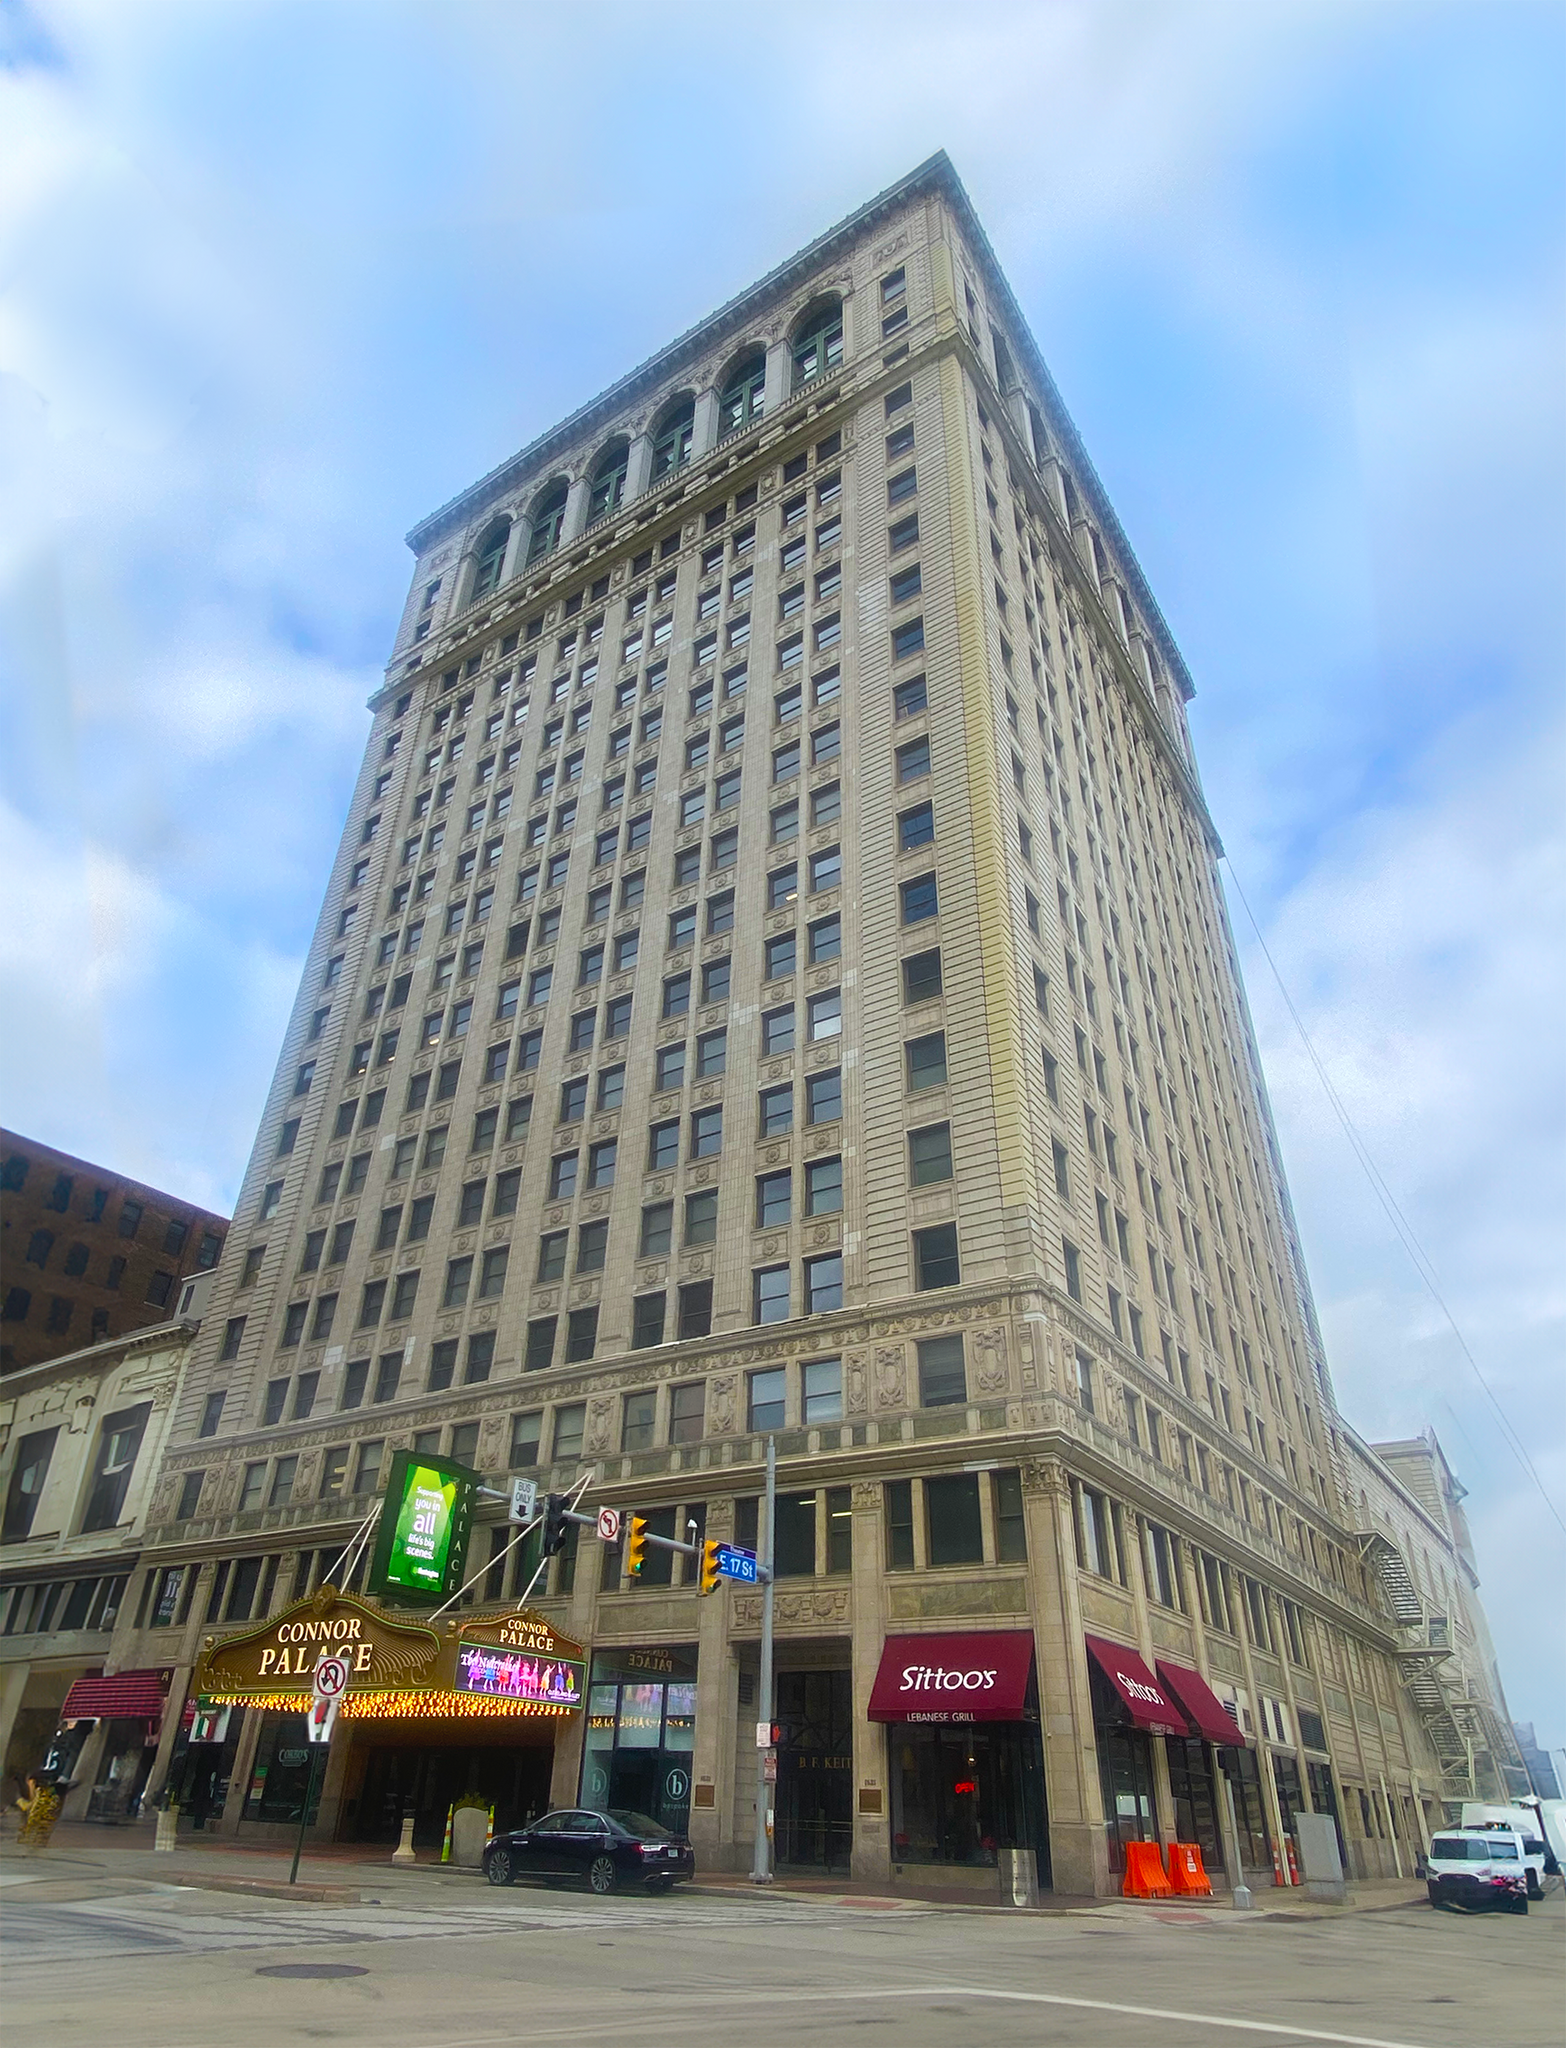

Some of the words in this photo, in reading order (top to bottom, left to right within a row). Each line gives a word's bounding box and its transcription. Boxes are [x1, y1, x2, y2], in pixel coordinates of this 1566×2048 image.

[416, 1485, 444, 1501] Supporting
[518, 1481, 532, 1493] BUS
[415, 1498, 428, 1511] you
[432, 1501, 441, 1512] in
[515, 1492, 532, 1504] ONLY
[413, 1512, 436, 1535] all
[408, 1533, 424, 1545] life's
[424, 1536, 435, 1549] big
[449, 1483, 472, 1591] PALACE
[406, 1546, 435, 1560] scenes.
[730, 1557, 741, 1574] 17
[742, 1560, 753, 1578] St
[277, 1618, 362, 1643] CONNOR
[507, 1619, 549, 1636] CONNOR
[499, 1629, 555, 1651] PALACE
[900, 1666, 998, 1691] Sittoo's
[906, 1712, 949, 1722] LEBANESE
[951, 1712, 976, 1722] GRILL
